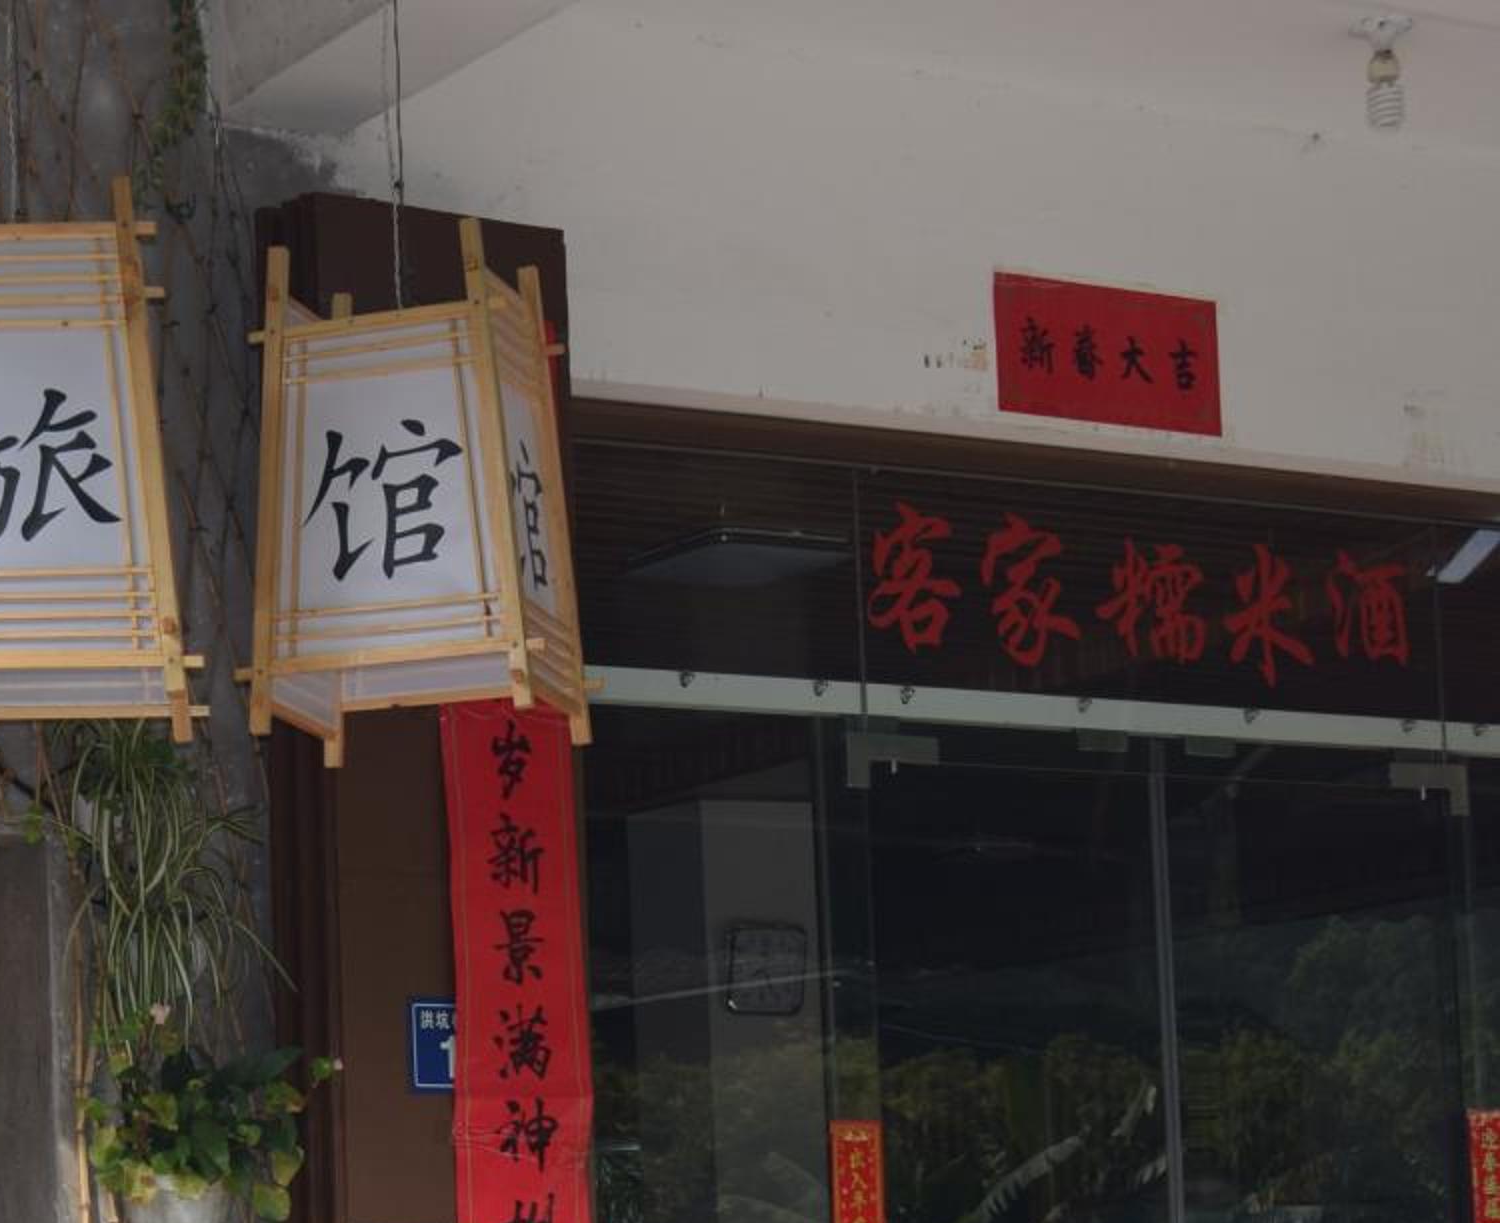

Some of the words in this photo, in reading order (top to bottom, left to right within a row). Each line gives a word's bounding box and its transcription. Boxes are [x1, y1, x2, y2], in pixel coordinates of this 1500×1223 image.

[1018, 316, 1199, 392] 新春大吉
[303, 418, 463, 582] 馆
[868, 502, 1411, 689] 客家糯米酒
[419, 1009, 456, 1030] 洪坑
